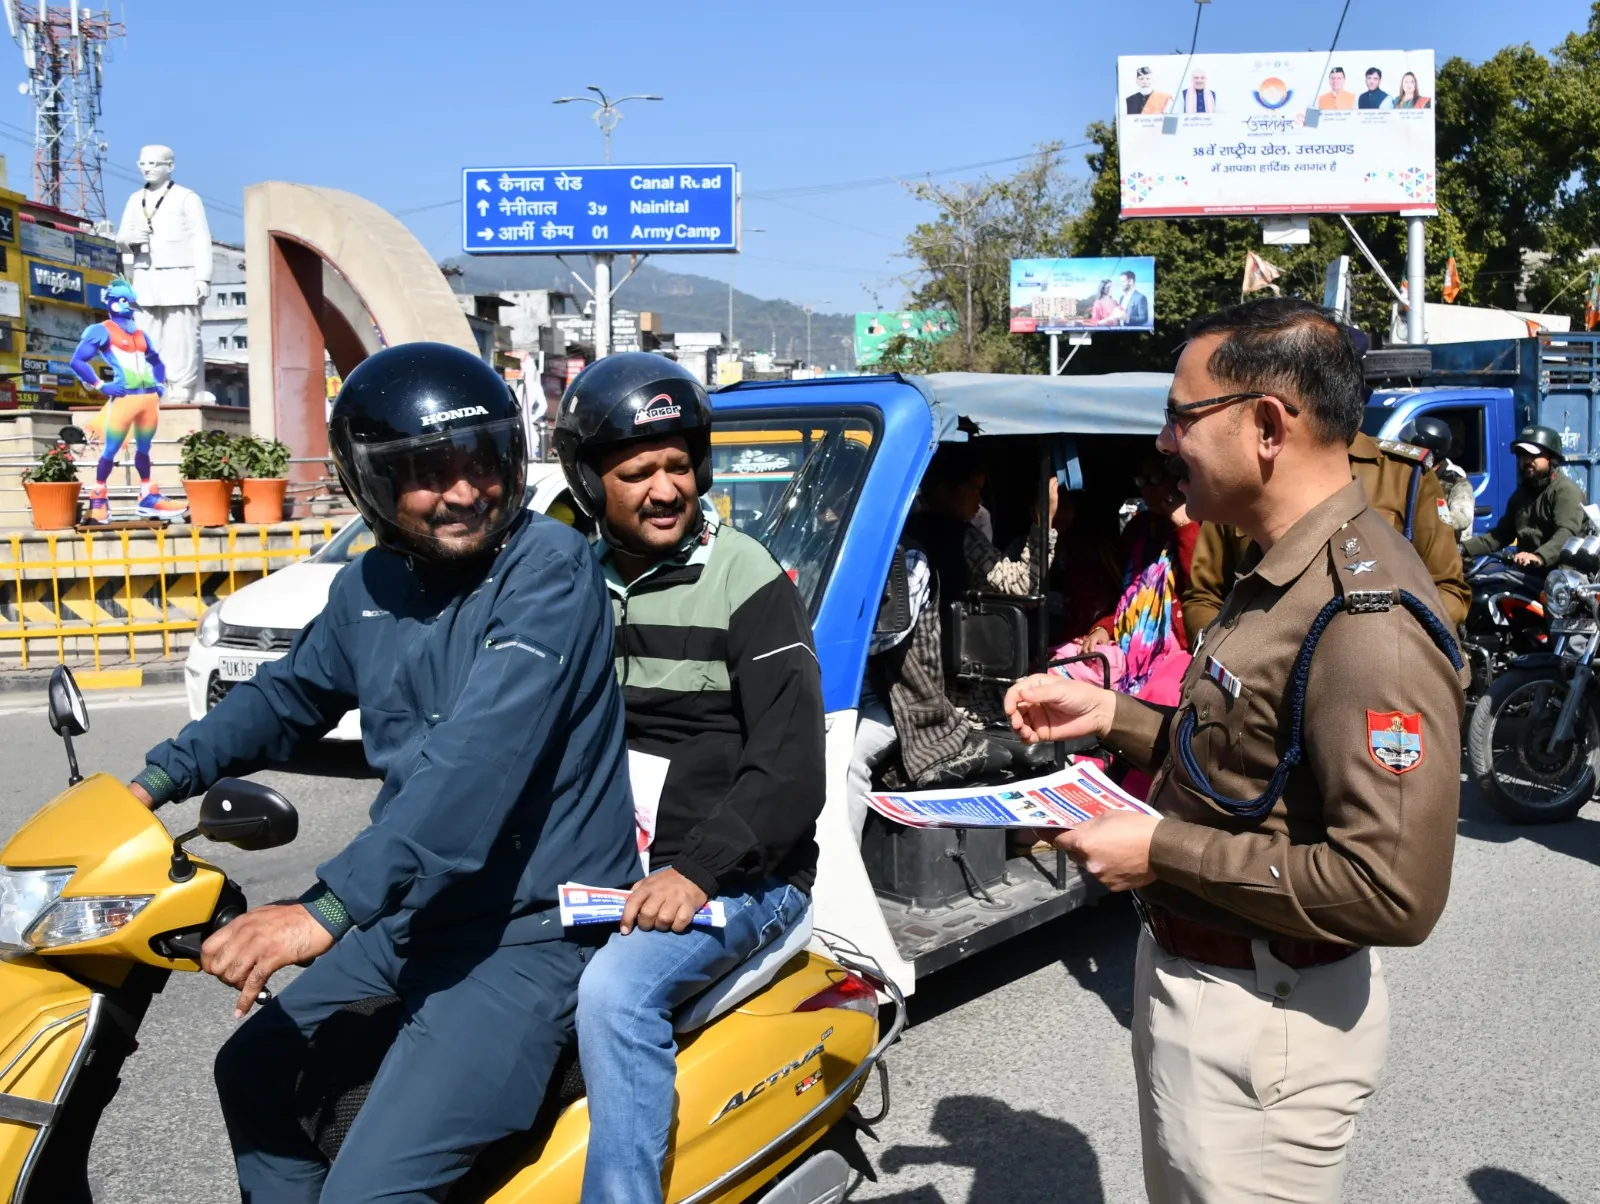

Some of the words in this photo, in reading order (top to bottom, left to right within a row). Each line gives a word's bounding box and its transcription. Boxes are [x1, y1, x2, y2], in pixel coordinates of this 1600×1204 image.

[1220, 142, 1257, 159] राष्ट्रीय
[1295, 144, 1354, 155] उत्तराखण्ड
[1211, 162, 1220, 173] में
[1223, 164, 1256, 173] आपका
[1259, 161, 1290, 172] हार्दिक
[1294, 163, 1327, 172] स्वागत
[1329, 161, 1337, 172] है
[498, 172, 545, 192] कैनाल
[553, 171, 583, 191] रोड
[630, 175, 674, 190] Canal
[498, 196, 557, 216] नैनीताल
[630, 199, 689, 214] Nainital
[498, 220, 535, 241] आर्मी
[541, 220, 574, 240] कैम्प
[592, 225, 608, 239] 01
[23, 359, 48, 371] SONY
[420, 405, 490, 427] HONDA
[226, 660, 259, 677] UK06
[709, 1042, 825, 1125] ACTIVA
